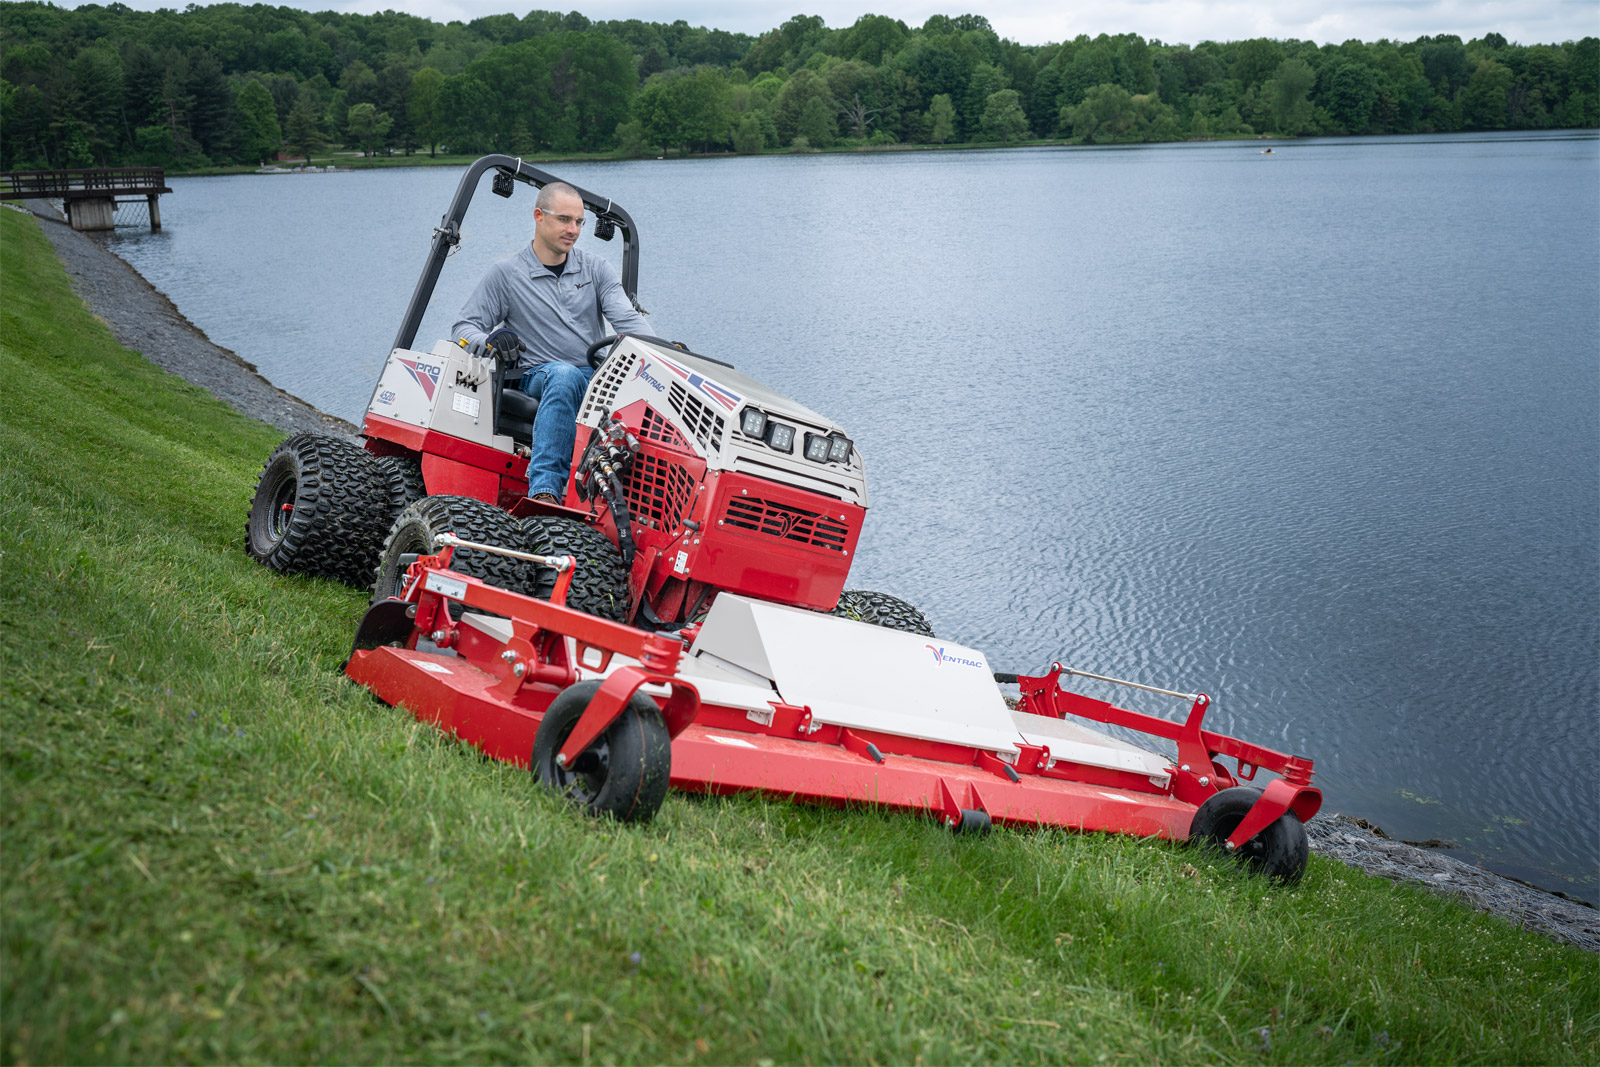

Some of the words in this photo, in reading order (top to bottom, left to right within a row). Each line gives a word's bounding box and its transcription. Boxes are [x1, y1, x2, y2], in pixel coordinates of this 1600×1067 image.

[415, 362, 441, 376] PRO
[631, 358, 665, 392] VENTRAC
[925, 644, 983, 668] VENTRAC
